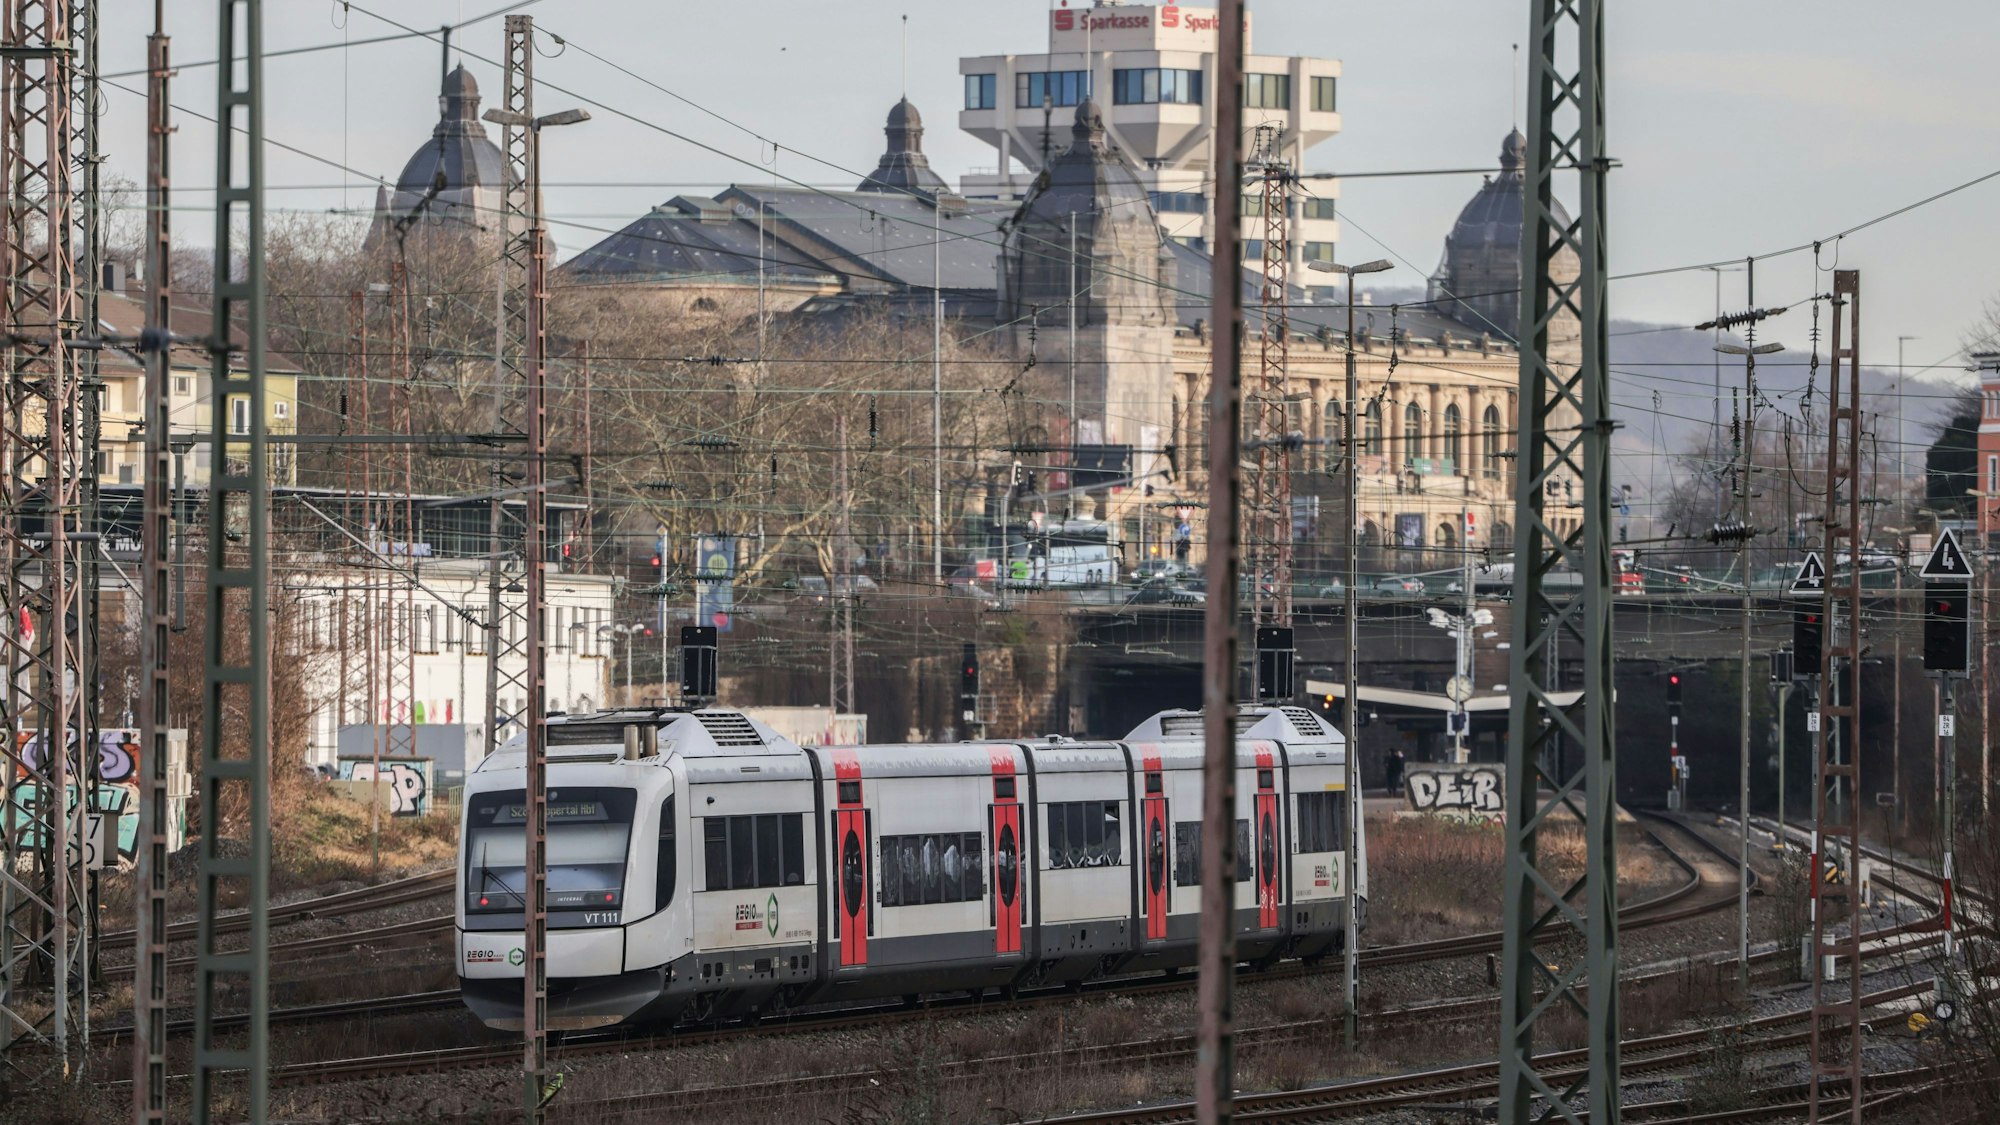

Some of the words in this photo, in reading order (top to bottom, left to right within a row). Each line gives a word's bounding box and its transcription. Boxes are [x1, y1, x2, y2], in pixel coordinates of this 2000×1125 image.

[1080, 13, 1150, 33] Sparkasse
[1942, 542, 1955, 571] 4
[1808, 564, 1819, 588] 4
[545, 803, 579, 817] ppertal
[580, 803, 596, 815] Hbf
[584, 913, 600, 924] VT
[601, 912, 618, 923] 111
